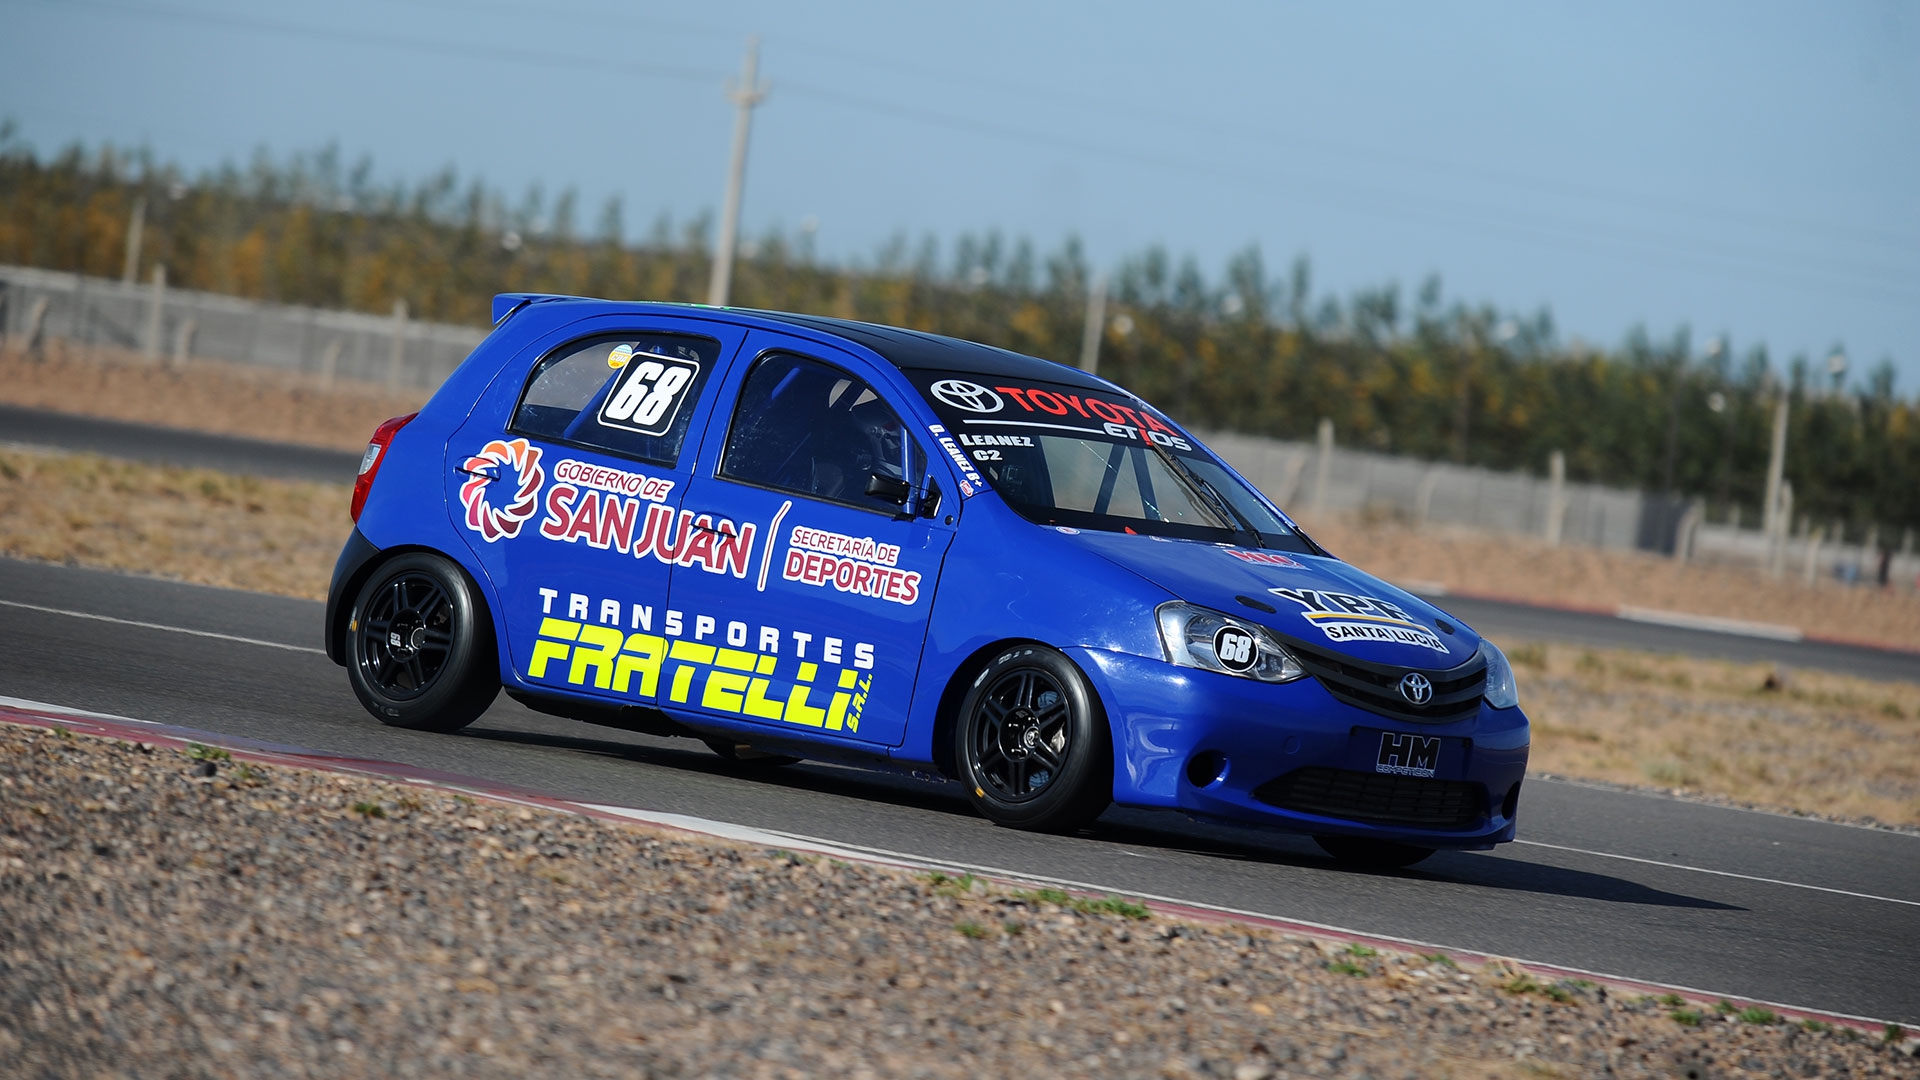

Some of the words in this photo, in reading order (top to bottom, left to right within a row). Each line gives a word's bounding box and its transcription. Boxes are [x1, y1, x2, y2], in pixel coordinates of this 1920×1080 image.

[605, 361, 692, 426] 68
[995, 386, 1179, 437] TOYOTA
[958, 433, 1035, 447] LEANEZ
[973, 449, 1003, 461] C2
[556, 461, 643, 493] GOBIERNO
[642, 480, 671, 499] DE
[939, 437, 975, 472] LEANEZ
[965, 472, 983, 487] B+
[542, 486, 637, 550] SAN
[635, 506, 754, 575] JUAN
[792, 528, 875, 559] SECRETARÍA
[876, 545, 898, 563] DE
[785, 550, 919, 602] DEPORTES
[1268, 587, 1413, 621] YPF
[538, 586, 875, 670] TRANSPORTES
[1219, 632, 1252, 663] 68
[1326, 625, 1390, 640] SANTA
[1390, 629, 1447, 651] LUCIA
[527, 616, 859, 732] FRATELLI
[1376, 731, 1441, 770] HM
